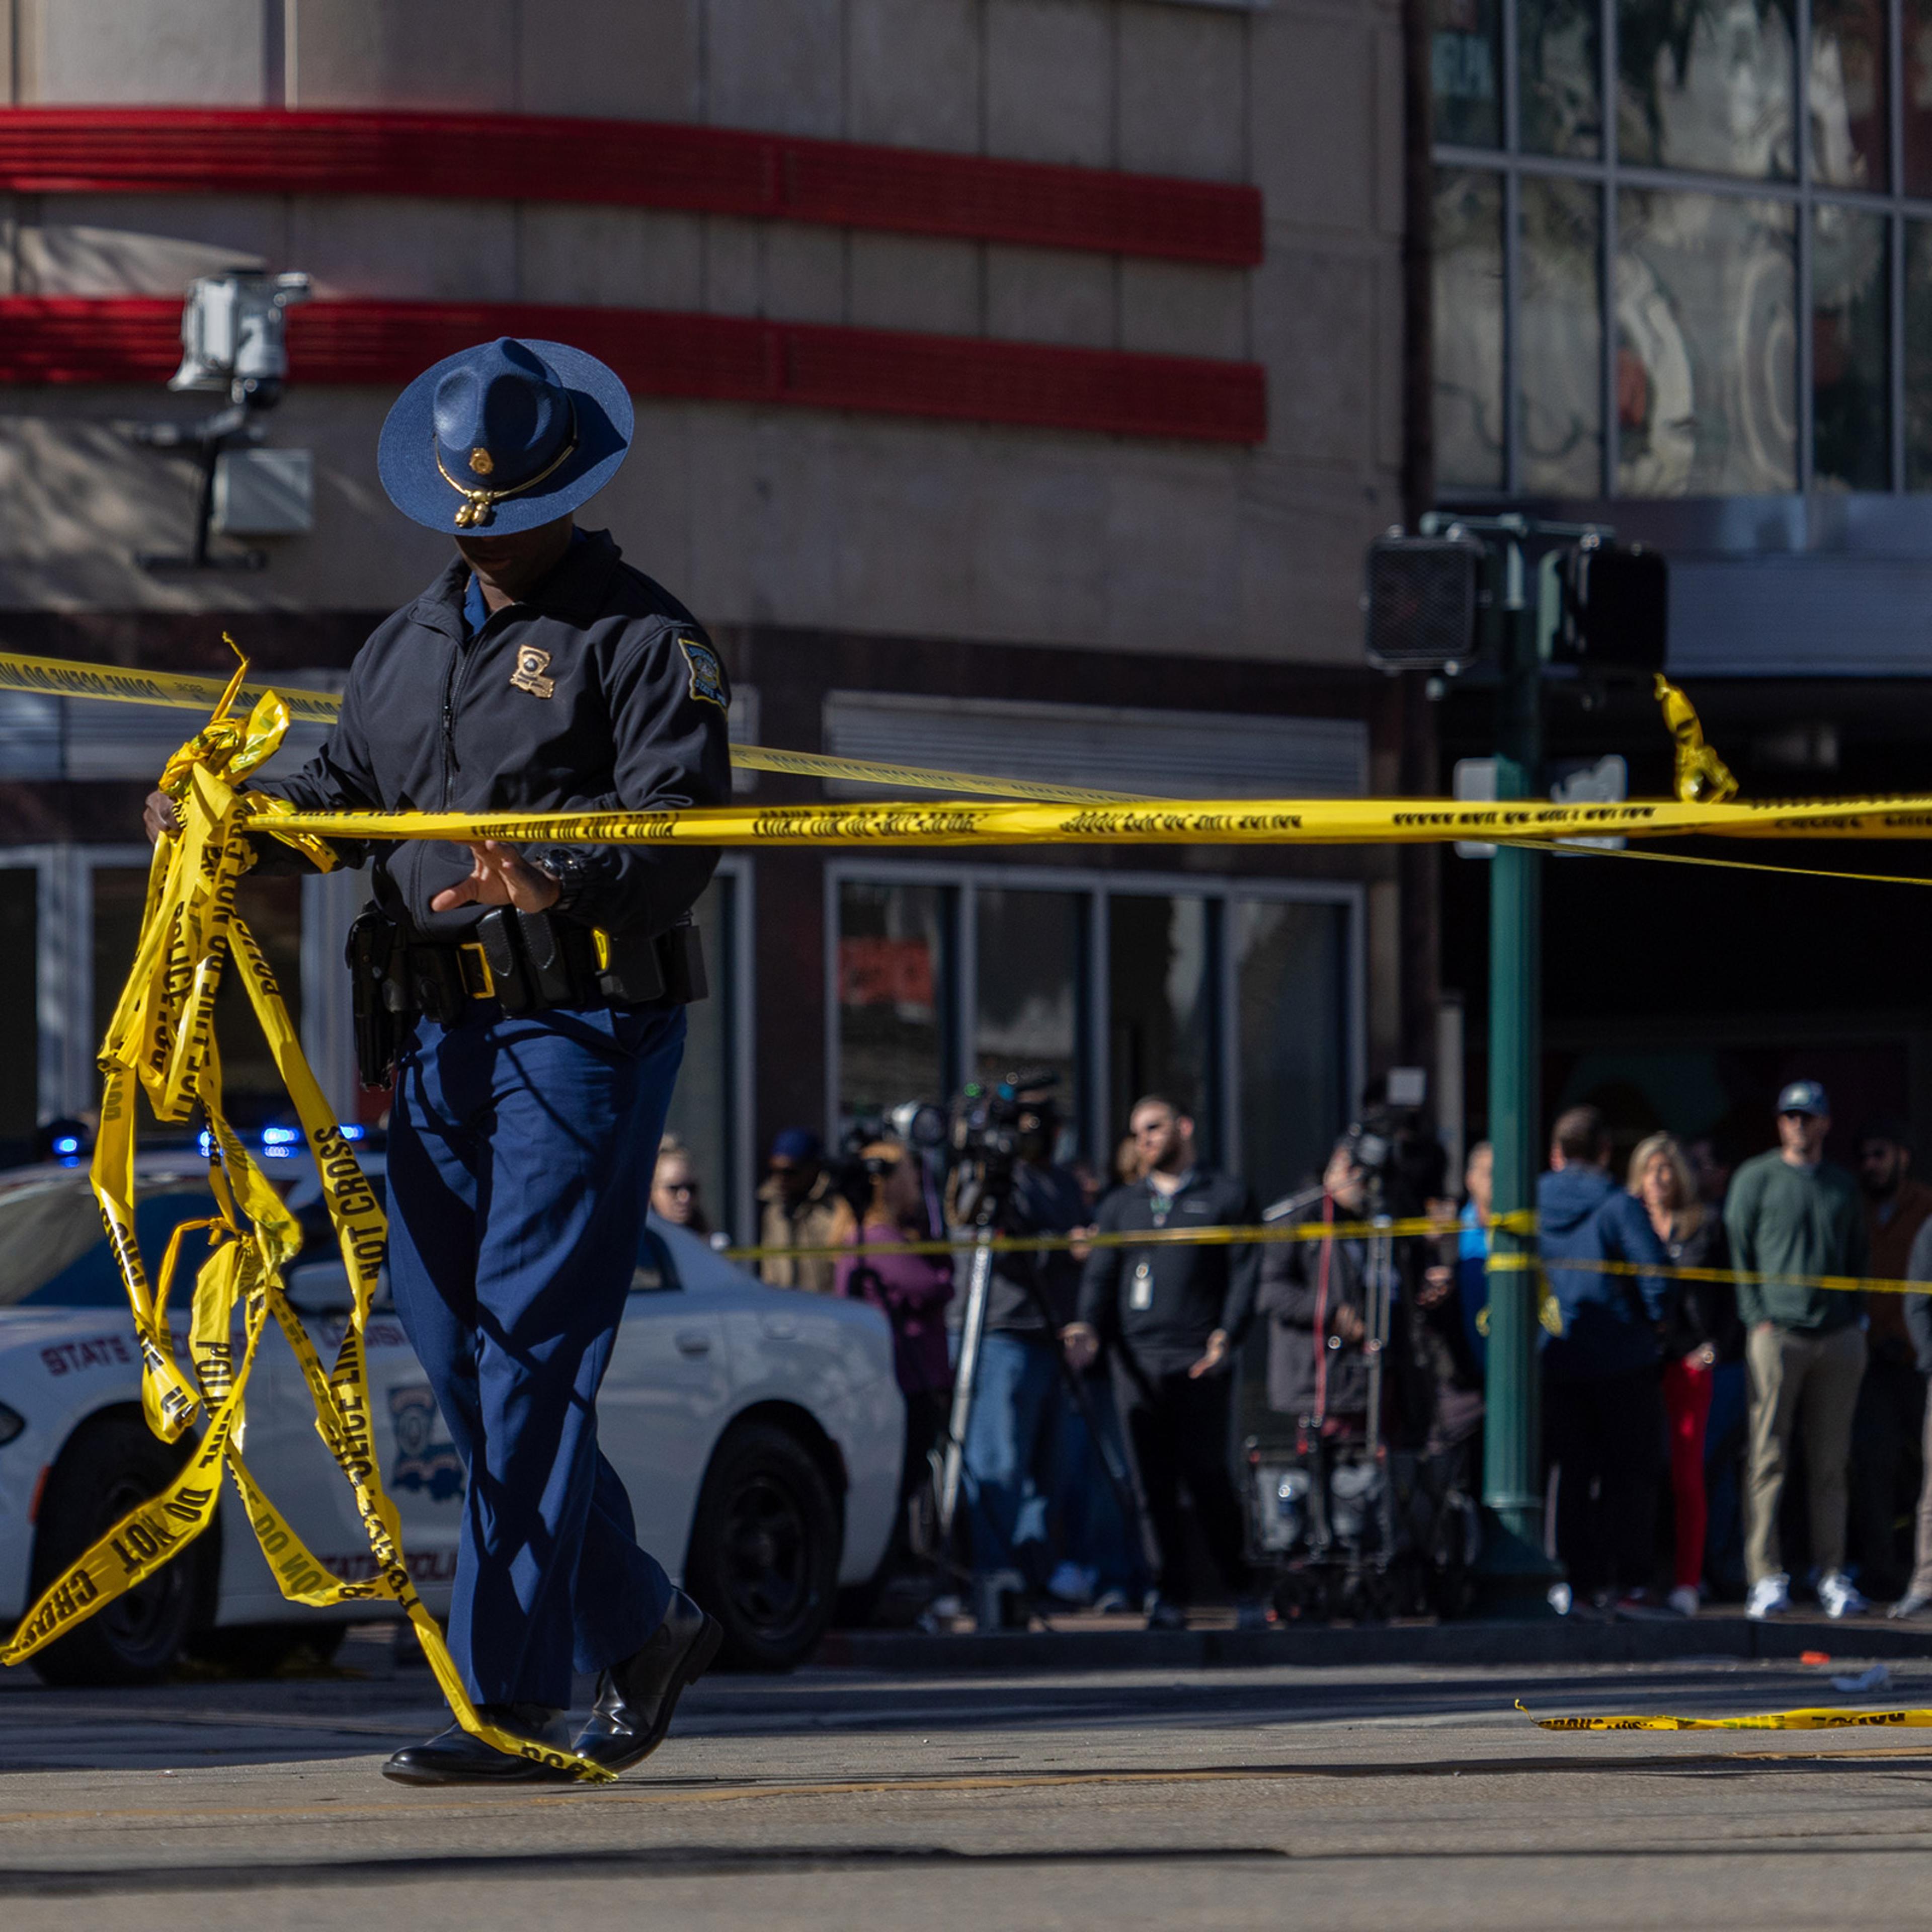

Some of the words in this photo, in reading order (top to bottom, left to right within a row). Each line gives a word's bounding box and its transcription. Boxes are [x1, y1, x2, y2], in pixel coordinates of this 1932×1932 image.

[314, 1125, 375, 1217] CROSS
[348, 1225, 385, 1281] NOT
[40, 1336, 132, 1377] STATE
[195, 1340, 231, 1412] POLI
[163, 1487, 213, 1523] DO
[110, 1515, 177, 1575] NOT
